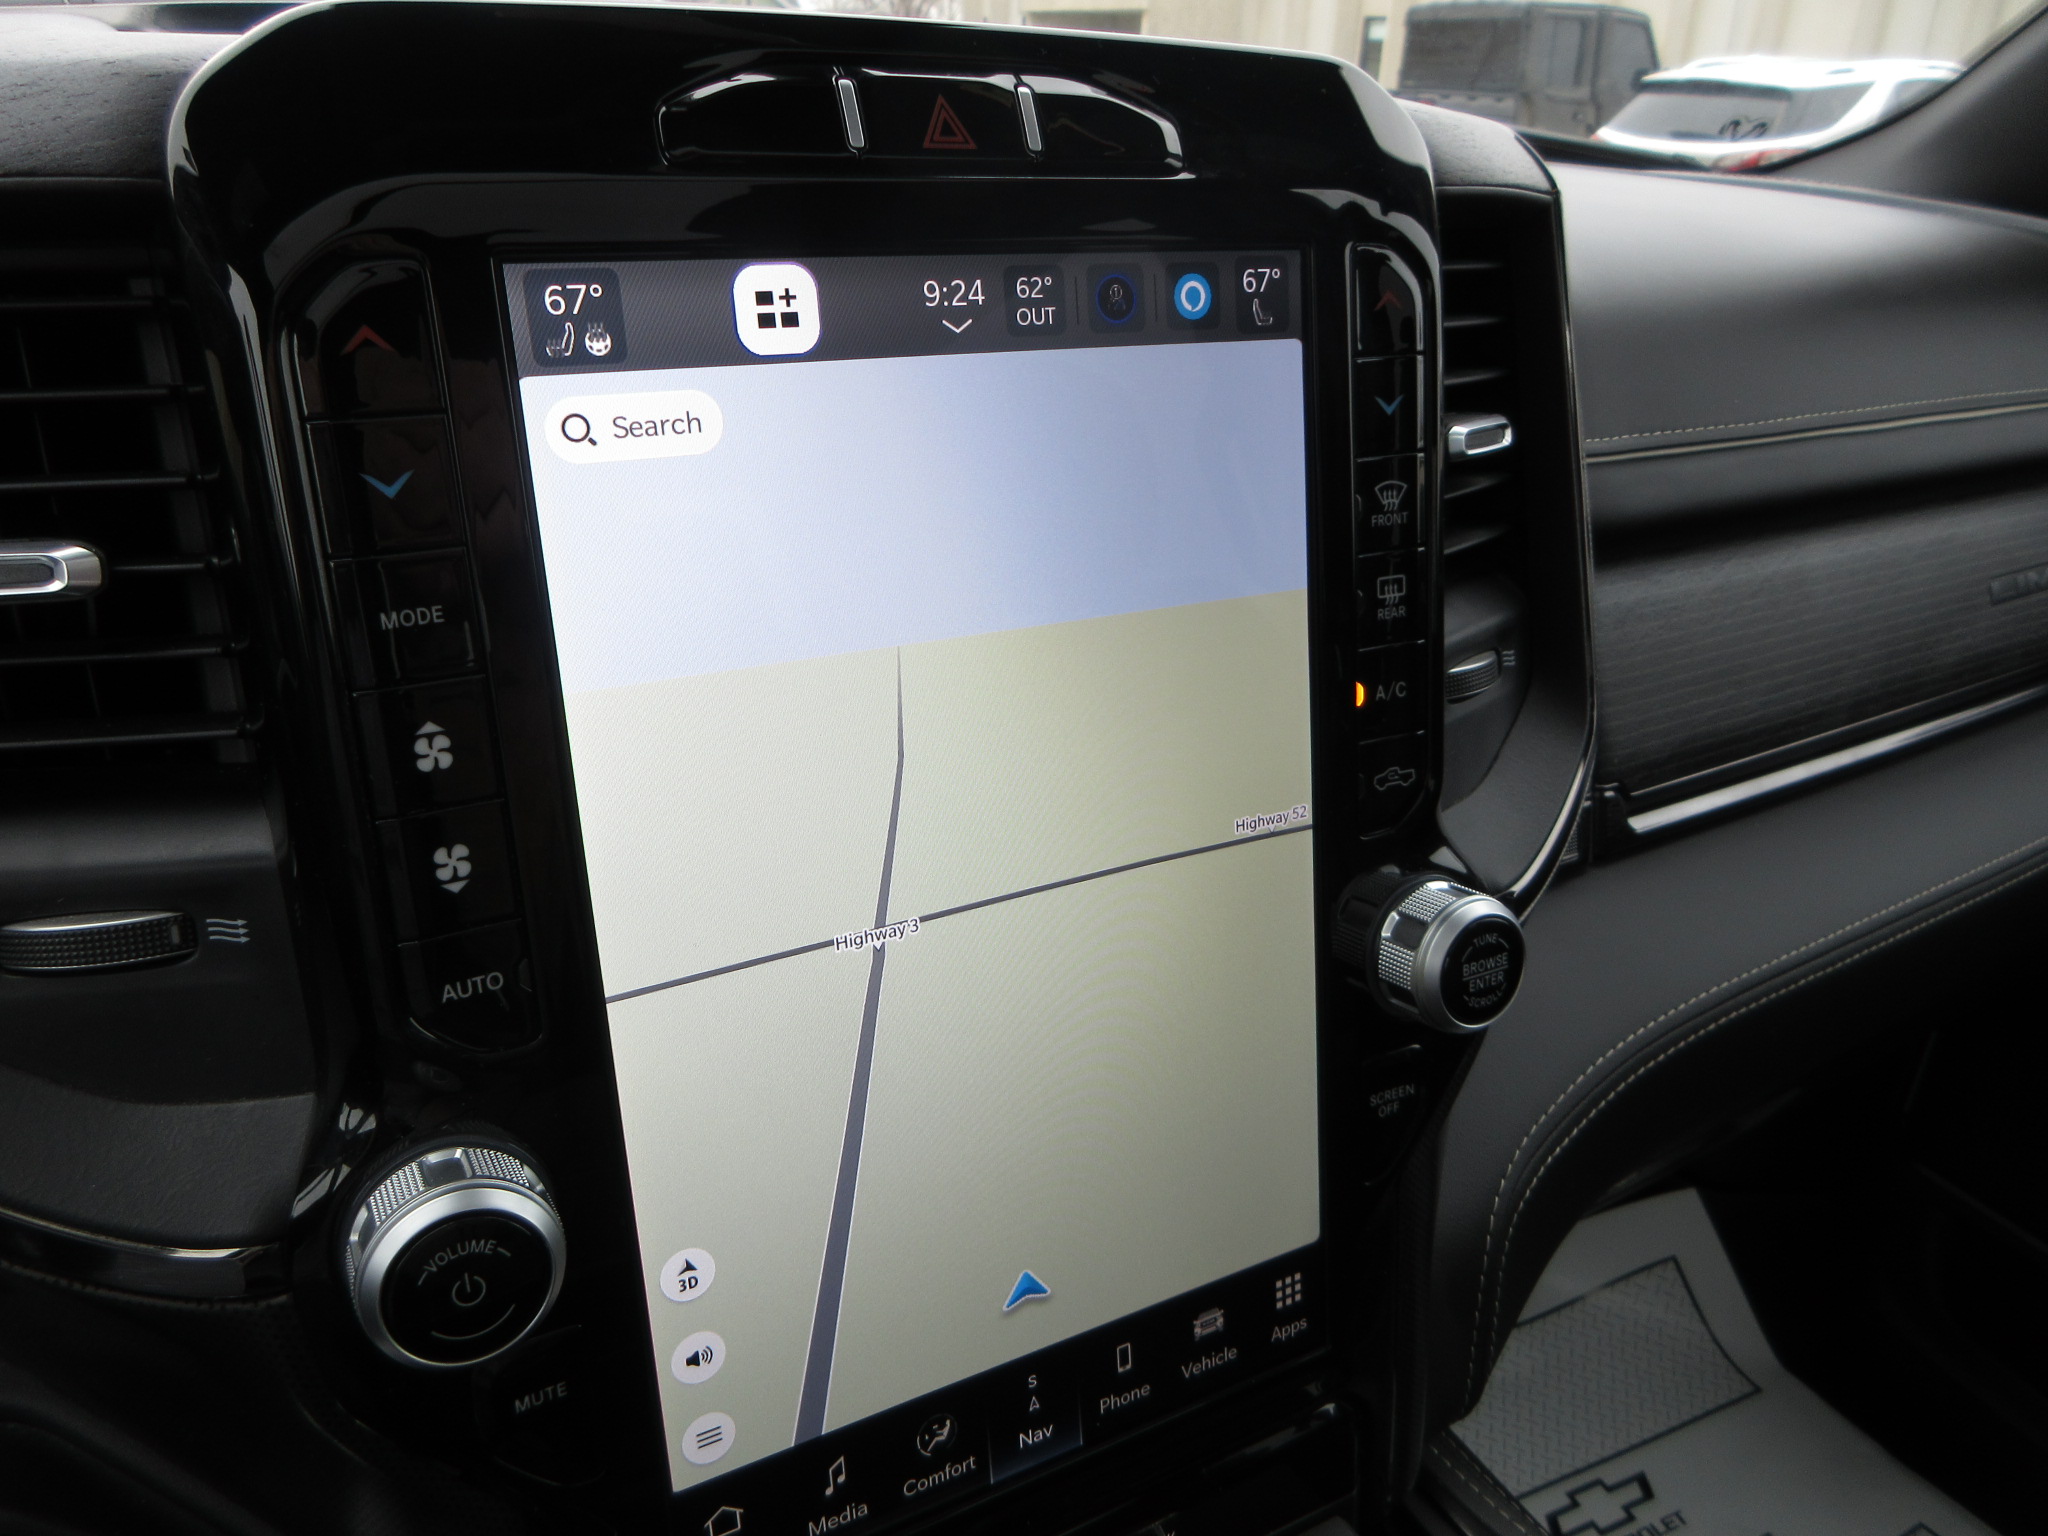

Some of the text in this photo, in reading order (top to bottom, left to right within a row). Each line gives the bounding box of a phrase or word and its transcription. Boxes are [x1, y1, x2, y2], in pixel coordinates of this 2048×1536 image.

[923, 279, 986, 308] 9:24
[1015, 276, 1053, 299] 62°
[1242, 268, 1281, 293] 67°
[544, 284, 603, 315] 67°
[1016, 307, 1056, 326] OUT
[612, 411, 703, 439] Search
[1371, 511, 1409, 527] FRONT
[380, 605, 445, 631] MODE
[1377, 605, 1406, 621] REAR
[1375, 681, 1407, 701] A/C
[1235, 805, 1308, 834] Highway 52
[835, 918, 919, 951] Highway 3
[1472, 932, 1499, 949] TUNE
[1462, 952, 1509, 978] BROWSE
[442, 971, 504, 1004] AUTO
[1468, 971, 1505, 993] ENTER
[1369, 1084, 1416, 1107] SCREEN
[1378, 1101, 1400, 1119] OFF
[422, 1238, 498, 1274] VOLUME
[678, 1276, 699, 1293] 3D
[1271, 1317, 1308, 1343] Apps
[1181, 1346, 1238, 1380] Vehicle
[514, 1381, 569, 1414] MUTE
[1100, 1384, 1151, 1415] Phone
[1019, 1424, 1054, 1449] Nav
[903, 1455, 977, 1497] Comfort
[808, 1502, 868, 1536] Media
